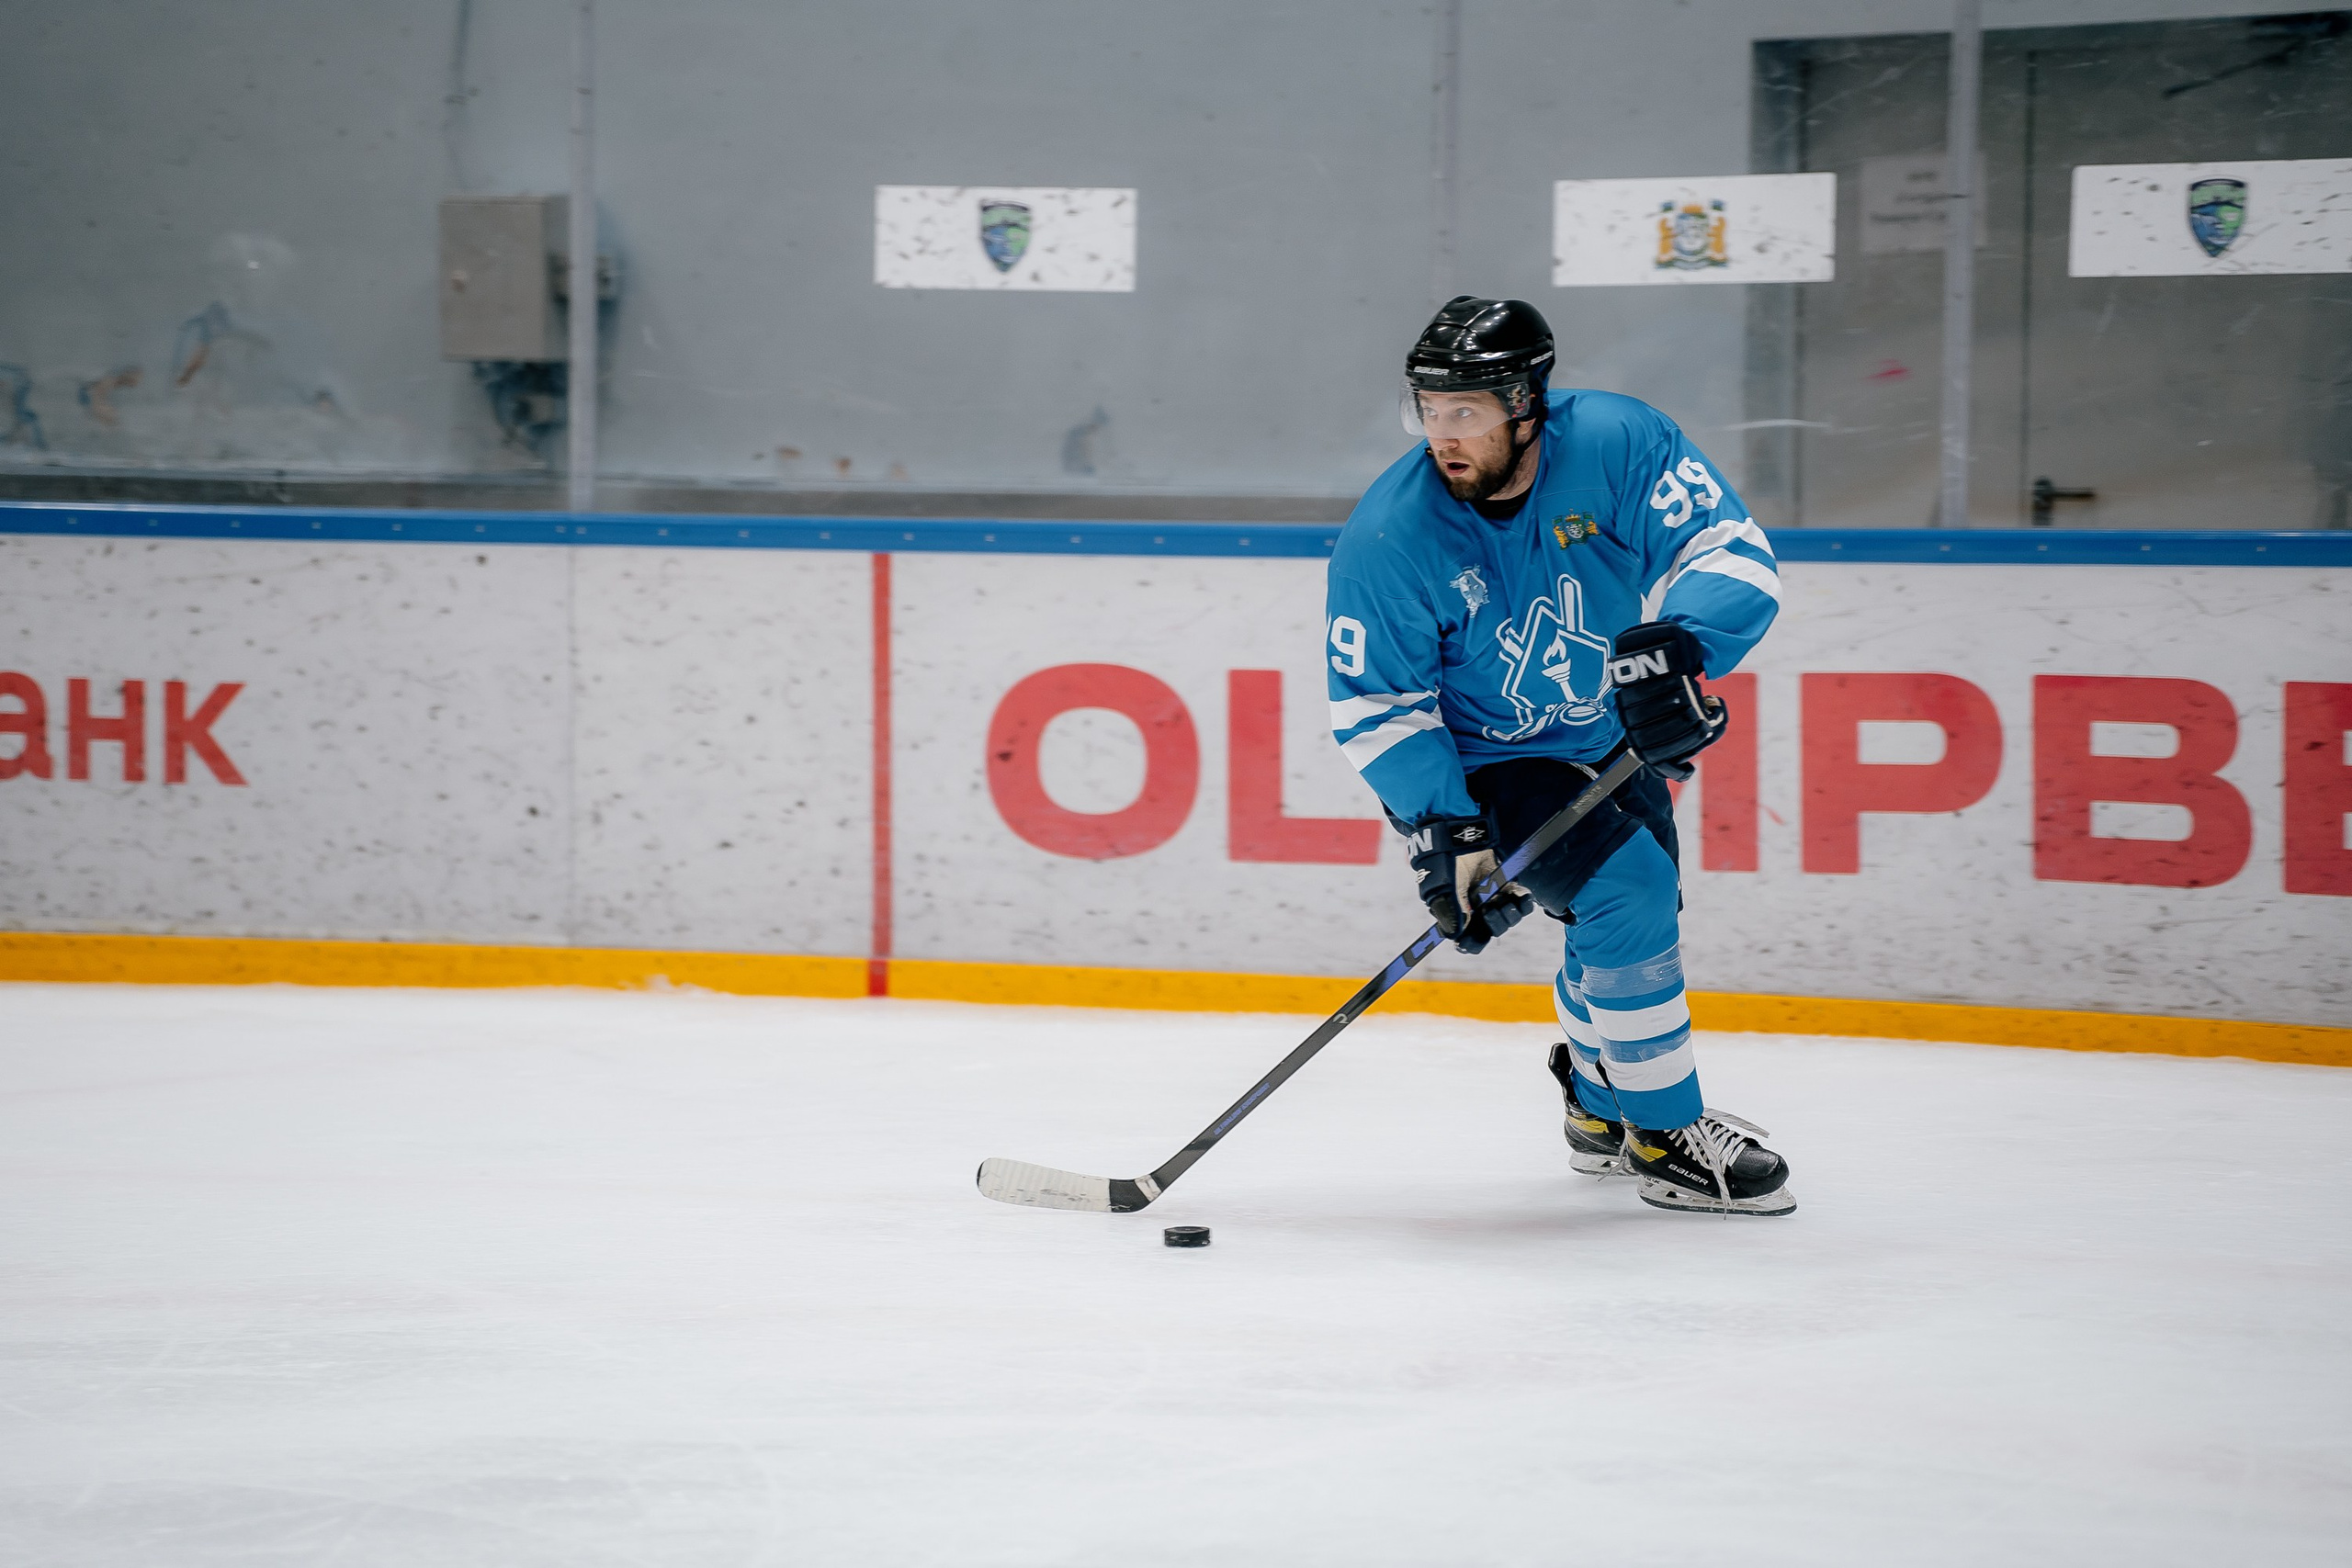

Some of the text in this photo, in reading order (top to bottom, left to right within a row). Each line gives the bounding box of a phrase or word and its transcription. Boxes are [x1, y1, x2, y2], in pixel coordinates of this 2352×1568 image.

[1649, 457, 1724, 529] 99
[1326, 612, 1367, 678] 9
[1668, 1163, 1709, 1186] BAUER
